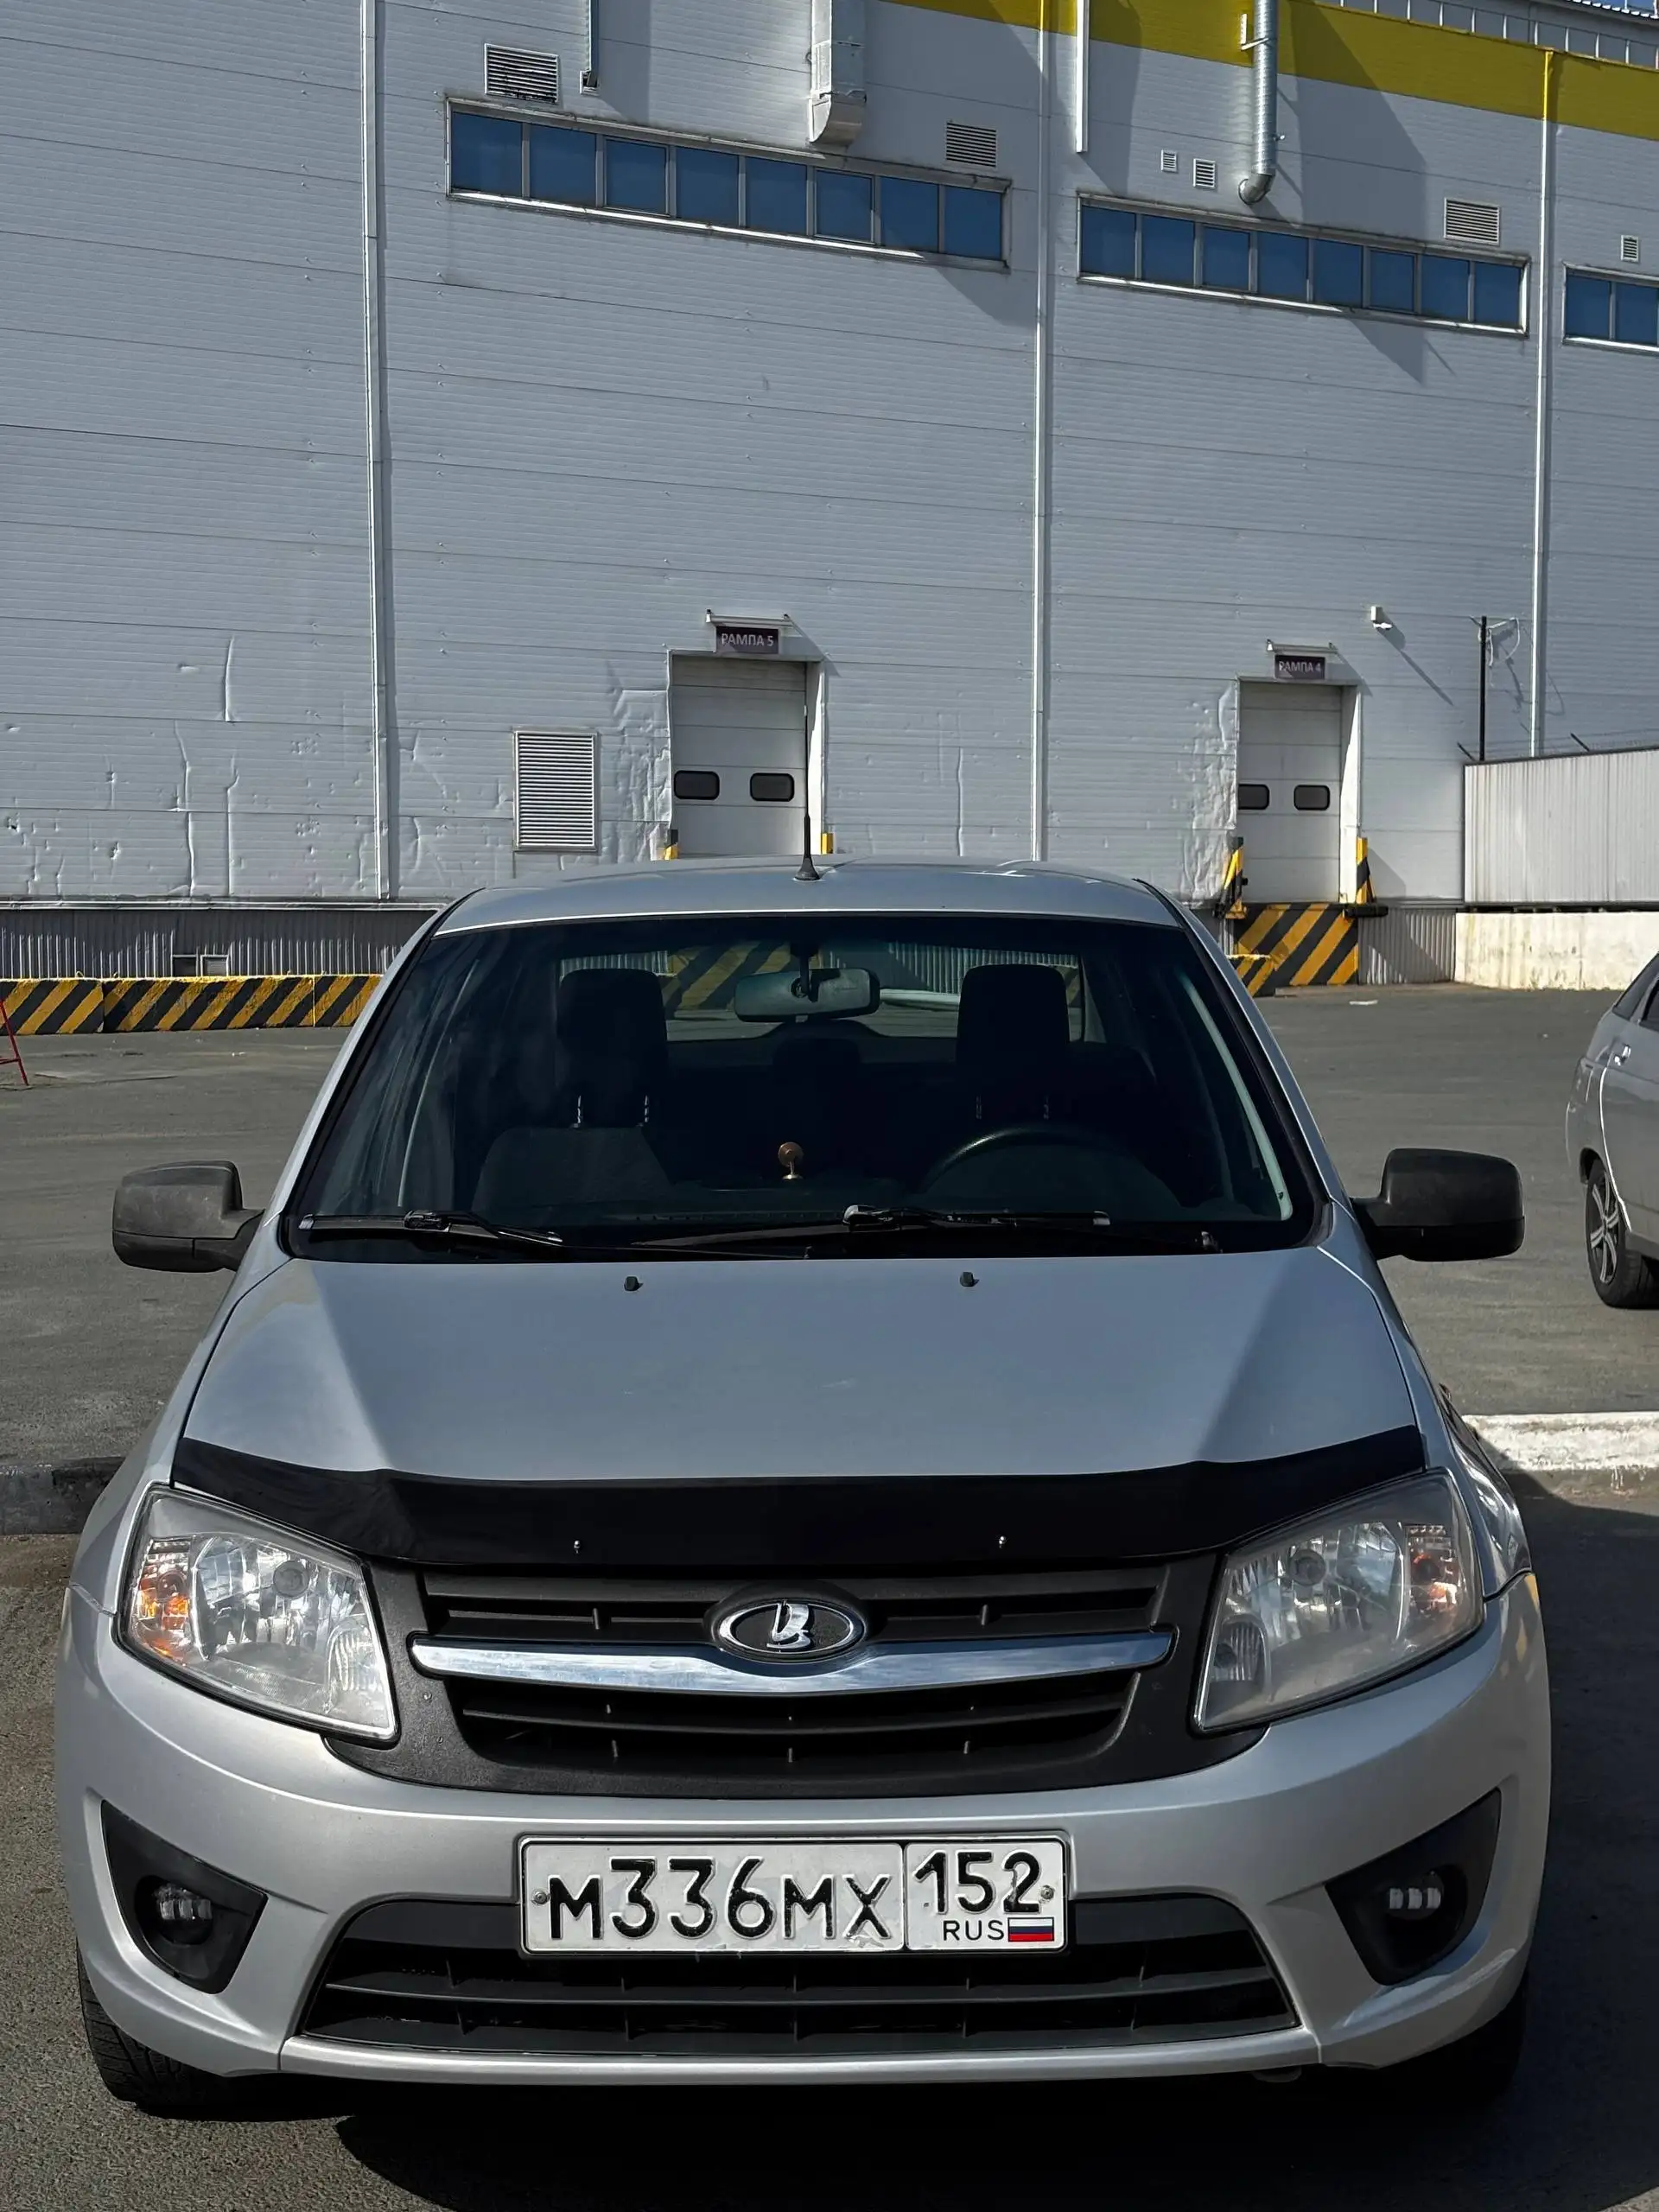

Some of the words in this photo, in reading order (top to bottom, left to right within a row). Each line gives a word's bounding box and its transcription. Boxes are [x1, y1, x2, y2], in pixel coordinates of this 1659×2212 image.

[721, 632, 765, 646] РАМПА
[766, 635, 774, 647] 5
[1279, 661, 1314, 672] РАМПА
[1315, 663, 1322, 672] 4
[548, 1857, 893, 1941] М336МХ
[913, 1851, 1042, 1914] 152
[943, 1920, 1005, 1942] RUS
